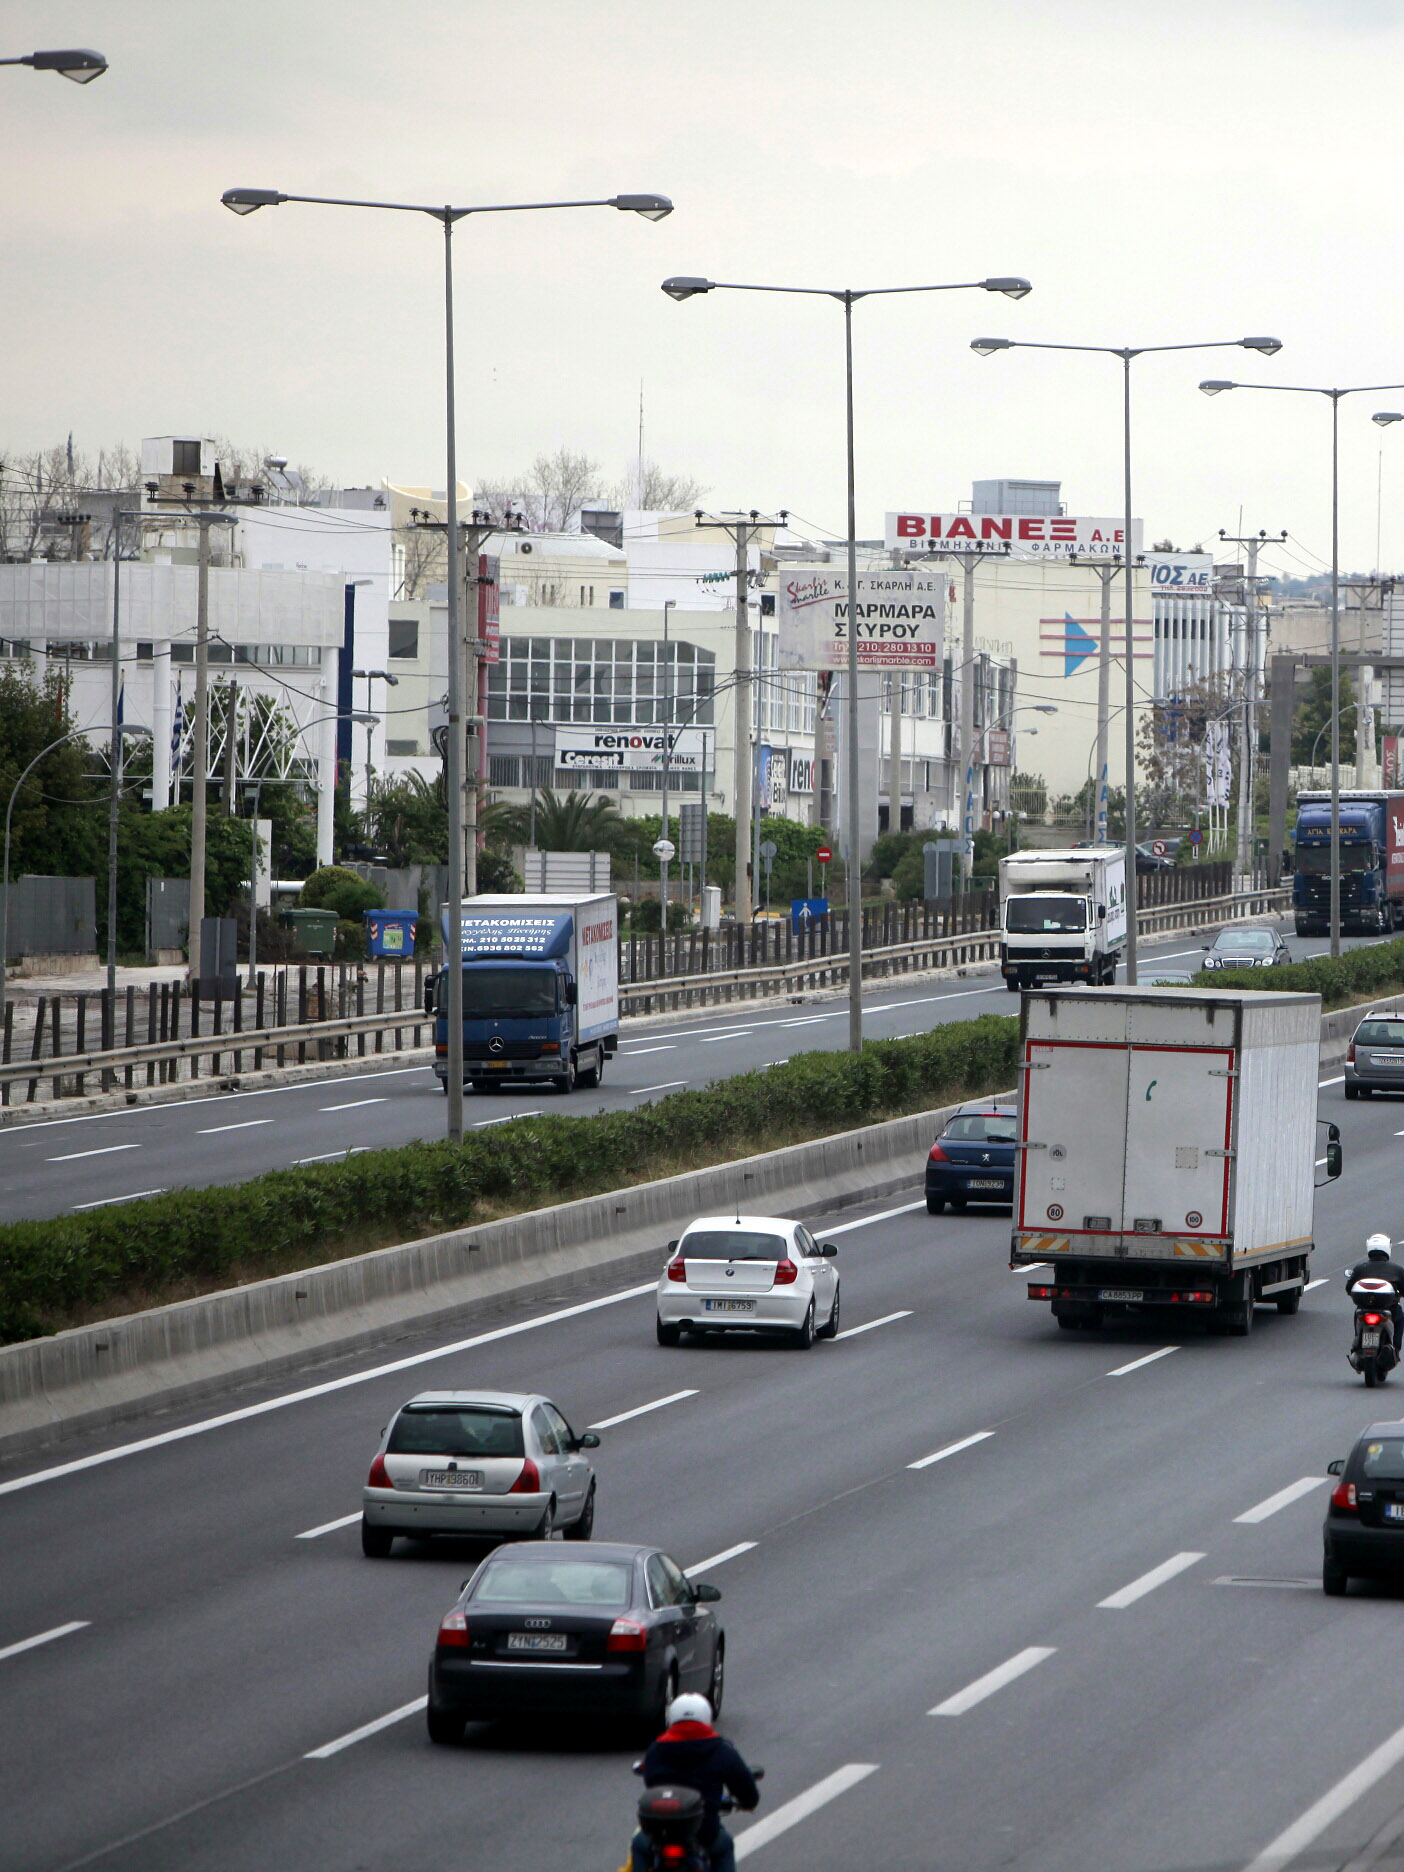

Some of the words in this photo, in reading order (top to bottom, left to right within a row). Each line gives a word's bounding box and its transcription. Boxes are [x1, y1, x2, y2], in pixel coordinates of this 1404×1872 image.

[897, 515, 1077, 541] ΒΙΑΝΕΞ
[1031, 543, 1120, 553] ΦΑΡΜΑΚΩΝ
[871, 580, 912, 591] ΣΚΑΡΛΗ
[916, 582, 936, 592] Α.Ε.
[834, 603, 936, 619] ΜΑΡΜΑΡΑ
[834, 622, 920, 638] ΣΚΥΡΟΥ
[884, 643, 903, 652] 280
[594, 733, 675, 749] renovat
[1050, 1208, 1060, 1217] 80
[732, 1301, 752, 1310] 6759
[429, 1473, 446, 1484] YHP
[451, 1473, 475, 1485] 9860
[535, 1634, 565, 1649] 2525
